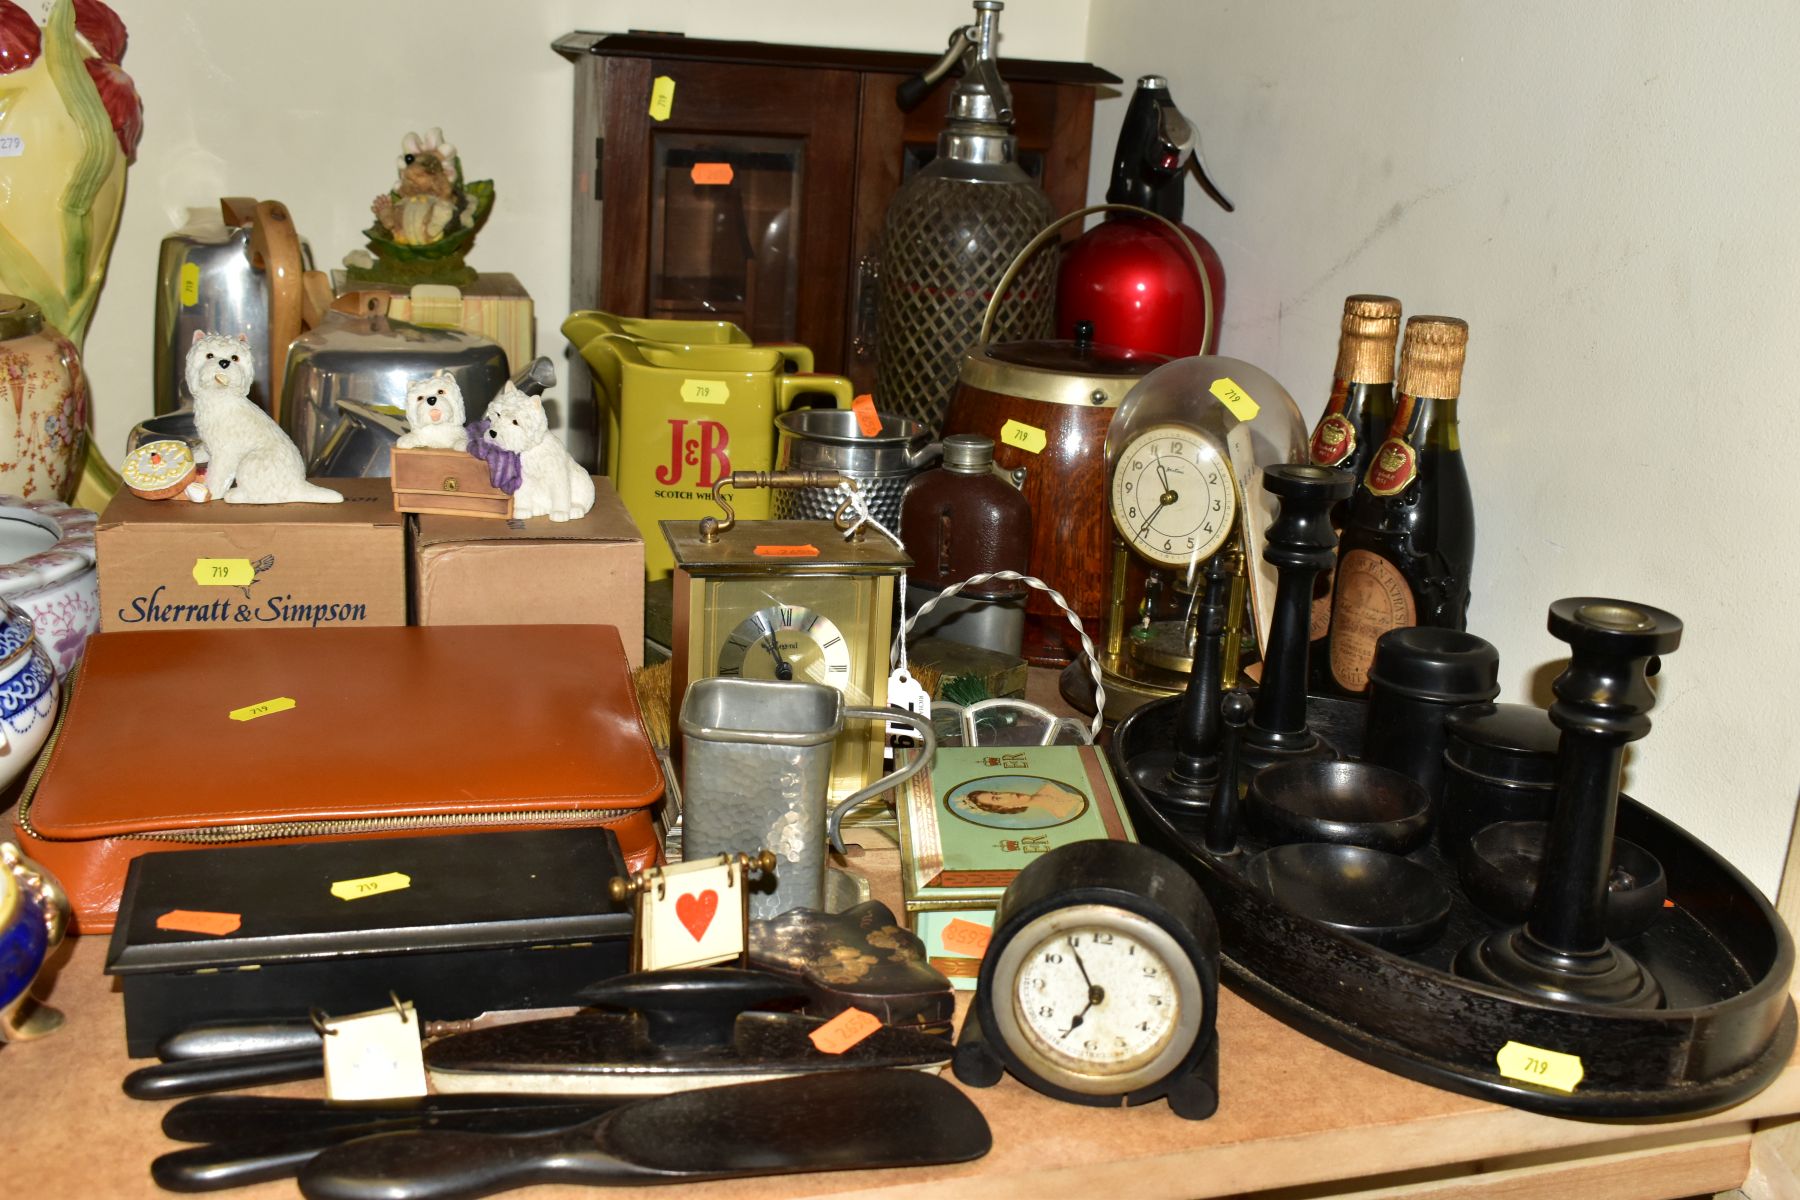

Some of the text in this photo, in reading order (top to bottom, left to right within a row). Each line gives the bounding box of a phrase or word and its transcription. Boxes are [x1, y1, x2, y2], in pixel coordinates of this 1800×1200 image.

[696, 386, 710, 397] 719
[1225, 389, 1241, 402] 719
[1014, 429, 1029, 441] 719
[1171, 441, 1183, 455] 12
[1132, 460, 1143, 471] 10
[1208, 473, 1217, 485] 2
[1125, 482, 1133, 494] 9
[655, 490, 734, 502] SCOTCH WHIKY
[1212, 499, 1221, 512] 3
[1128, 506, 1136, 518] 8
[1204, 522, 1213, 534] 4
[1163, 539, 1172, 550] 6
[1186, 537, 1195, 549] 5
[212, 566, 229, 578] 719
[118, 585, 367, 628] Sherratt & Simpson
[780, 608, 792, 627] XII
[249, 706, 268, 715] 719
[1002, 752, 1029, 769] ER
[1021, 834, 1049, 854] ER
[356, 882, 378, 893] 719
[1092, 933, 1114, 945] 12
[1128, 945, 1135, 956] 1
[1044, 953, 1063, 964] 10
[1143, 966, 1157, 978] 2
[1039, 1005, 1053, 1019] 8
[1135, 1020, 1151, 1032] 4
[1083, 1039, 1098, 1051] 6
[1524, 1057, 1548, 1075] 719
